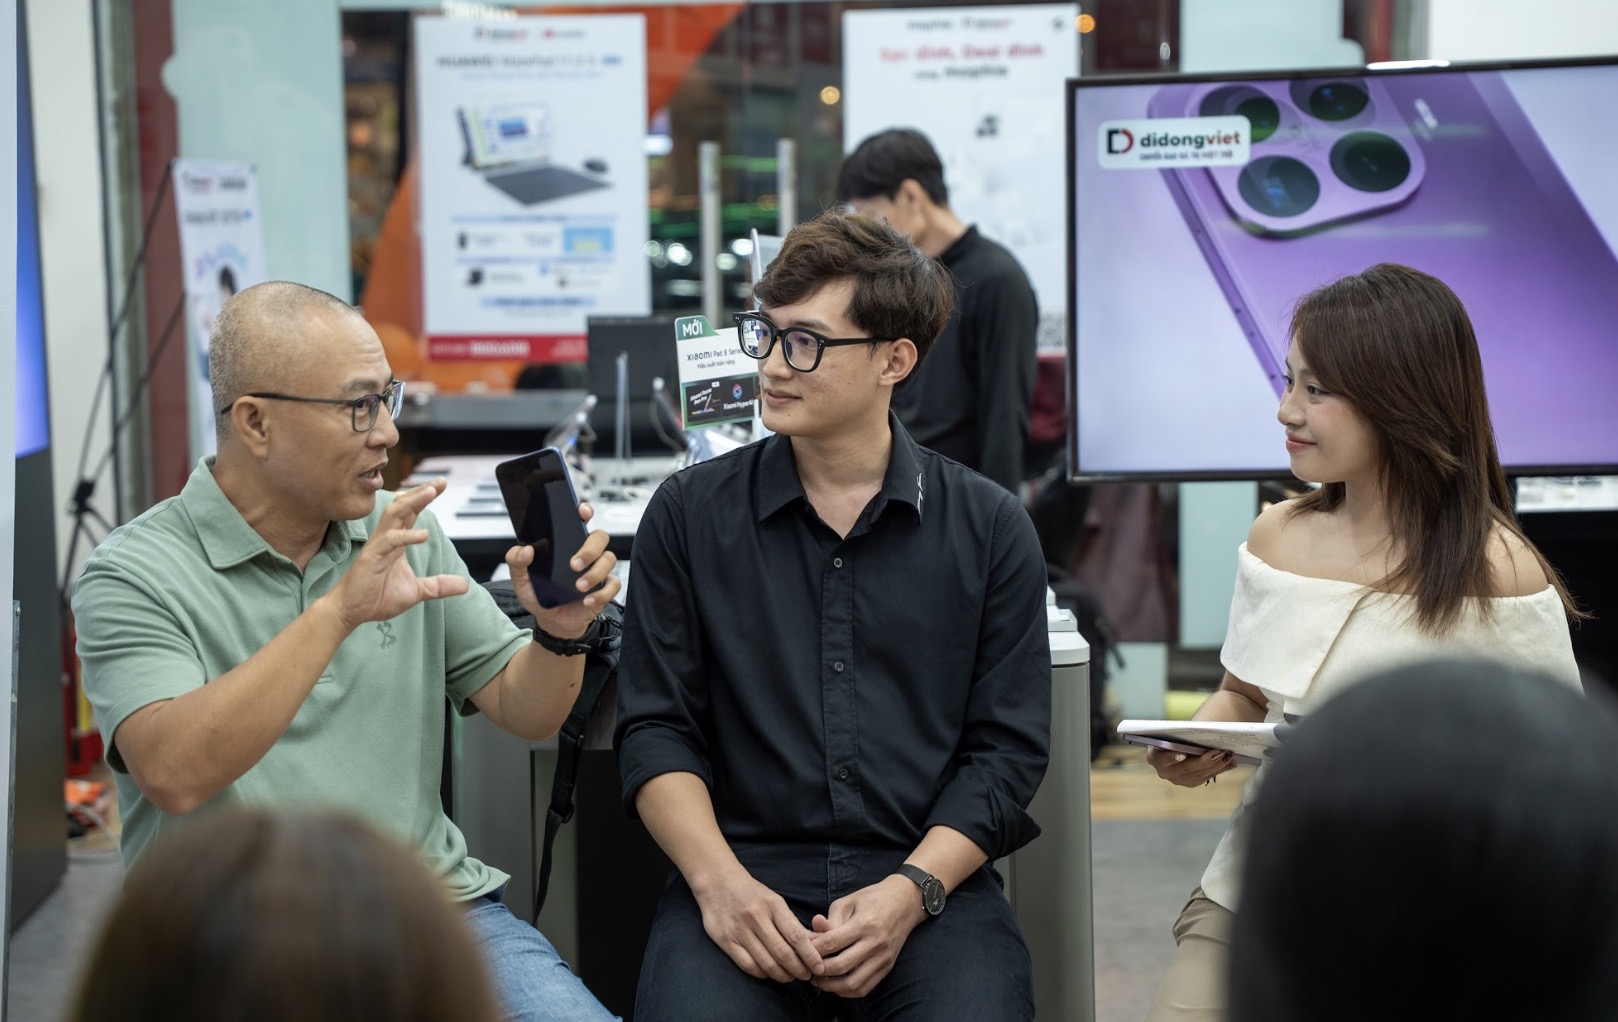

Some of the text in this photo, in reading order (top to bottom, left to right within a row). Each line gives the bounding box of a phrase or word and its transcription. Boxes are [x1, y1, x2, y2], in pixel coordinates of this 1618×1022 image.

[1140, 130, 1240, 149] didongviet
[682, 319, 703, 337] MỚI
[687, 351, 713, 362] xiaomi
[713, 349, 723, 358] Pad
